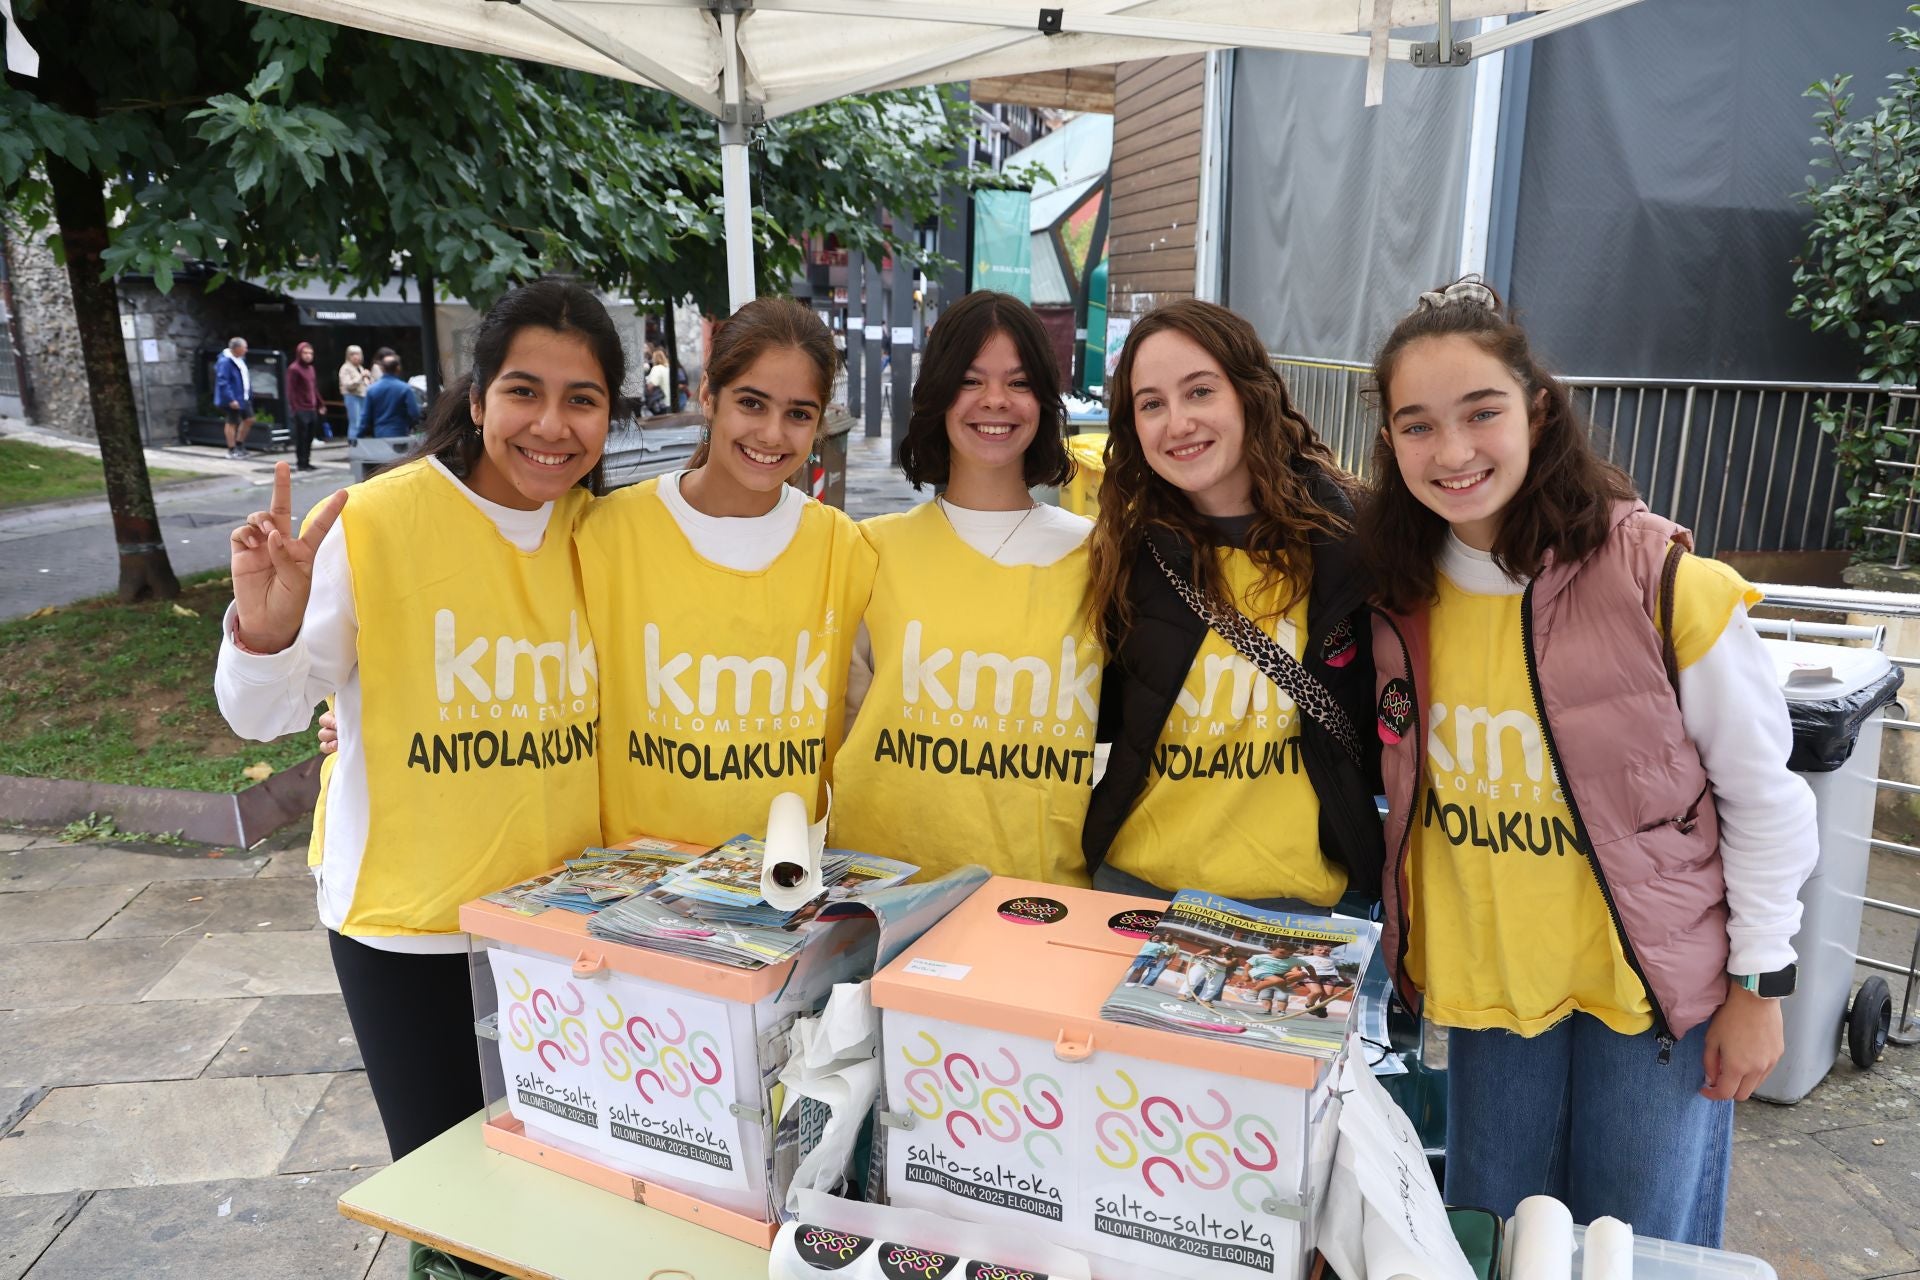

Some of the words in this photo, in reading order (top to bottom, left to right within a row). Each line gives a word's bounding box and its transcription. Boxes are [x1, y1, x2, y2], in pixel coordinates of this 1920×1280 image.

[643, 622, 829, 716] kmk
[902, 619, 1100, 721] kmk
[648, 708, 826, 733] KILOMETROA
[1174, 911, 1216, 927] URRIAK
[1177, 903, 1258, 930] KILOMETROAK
[1260, 925, 1290, 936] 2025
[1292, 929, 1353, 942] ELGOIBAR
[1178, 894, 1358, 935] salto-saltoka
[519, 1092, 567, 1117] KILOMETROAK
[567, 1108, 586, 1123] 2025
[587, 1114, 598, 1127] EL
[609, 1103, 730, 1153] salto-saltoka
[611, 1126, 667, 1151] KILOMETROAK
[667, 1140, 689, 1156] 2025
[690, 1146, 730, 1168] ELGOIBAR
[907, 1143, 1063, 1203] salto-saltoka
[908, 1167, 977, 1198] KILOMETROAK
[978, 1188, 1005, 1205] 2025
[1007, 1194, 1060, 1219] ELGOIBAR
[1095, 1193, 1275, 1251] salto-saltoka
[1096, 1217, 1178, 1249] KILOMETROAK
[1179, 1238, 1209, 1256] 2025
[1212, 1245, 1272, 1270] ELGOIBAR
